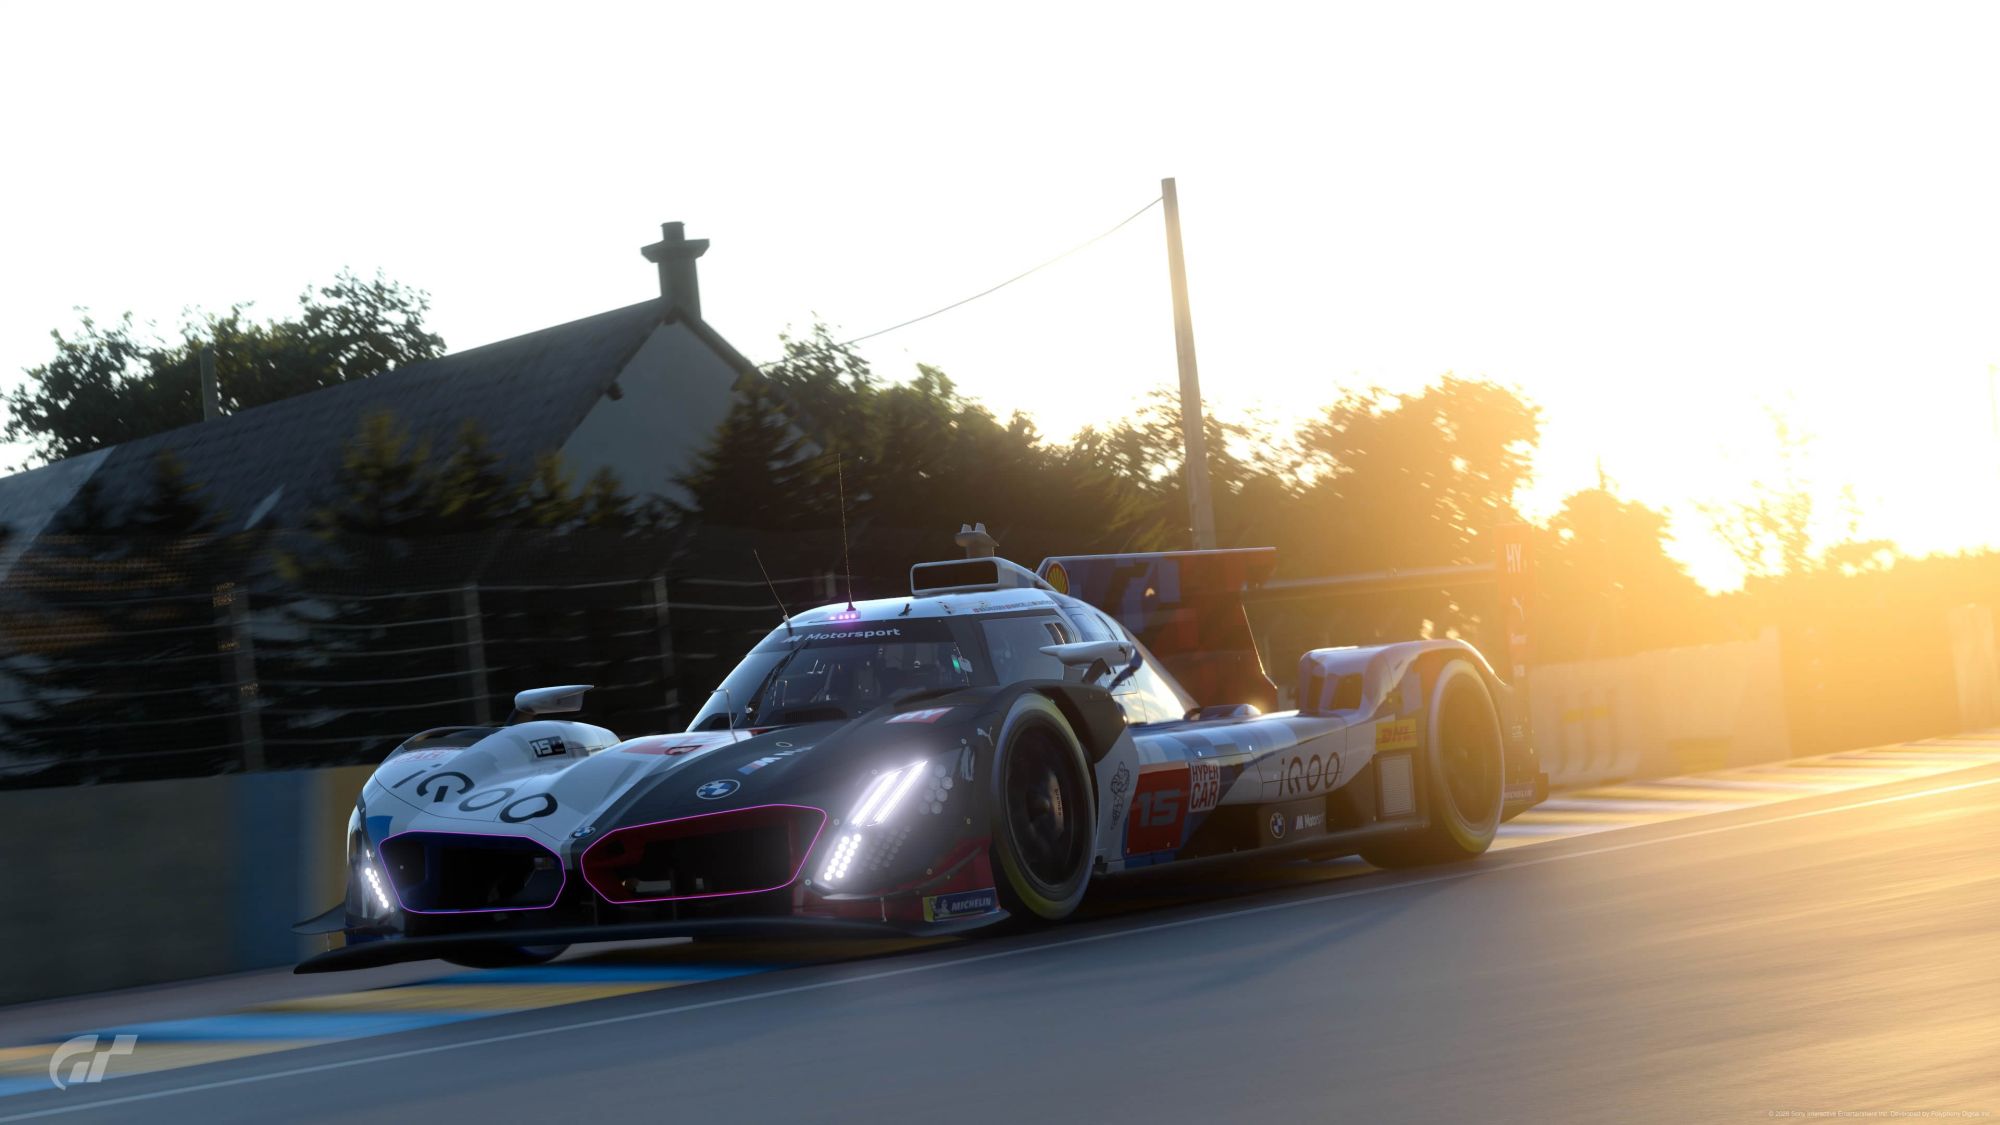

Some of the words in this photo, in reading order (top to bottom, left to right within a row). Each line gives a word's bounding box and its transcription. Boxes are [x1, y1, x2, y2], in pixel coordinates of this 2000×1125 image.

[805, 628, 901, 641] Motorsport
[530, 739, 553, 756] 15
[1191, 763, 1219, 782] HYPER
[1278, 752, 1340, 796] iQOO
[1190, 781, 1218, 809] CAR
[1137, 788, 1181, 828] 15
[952, 897, 991, 912] MICHELIN
